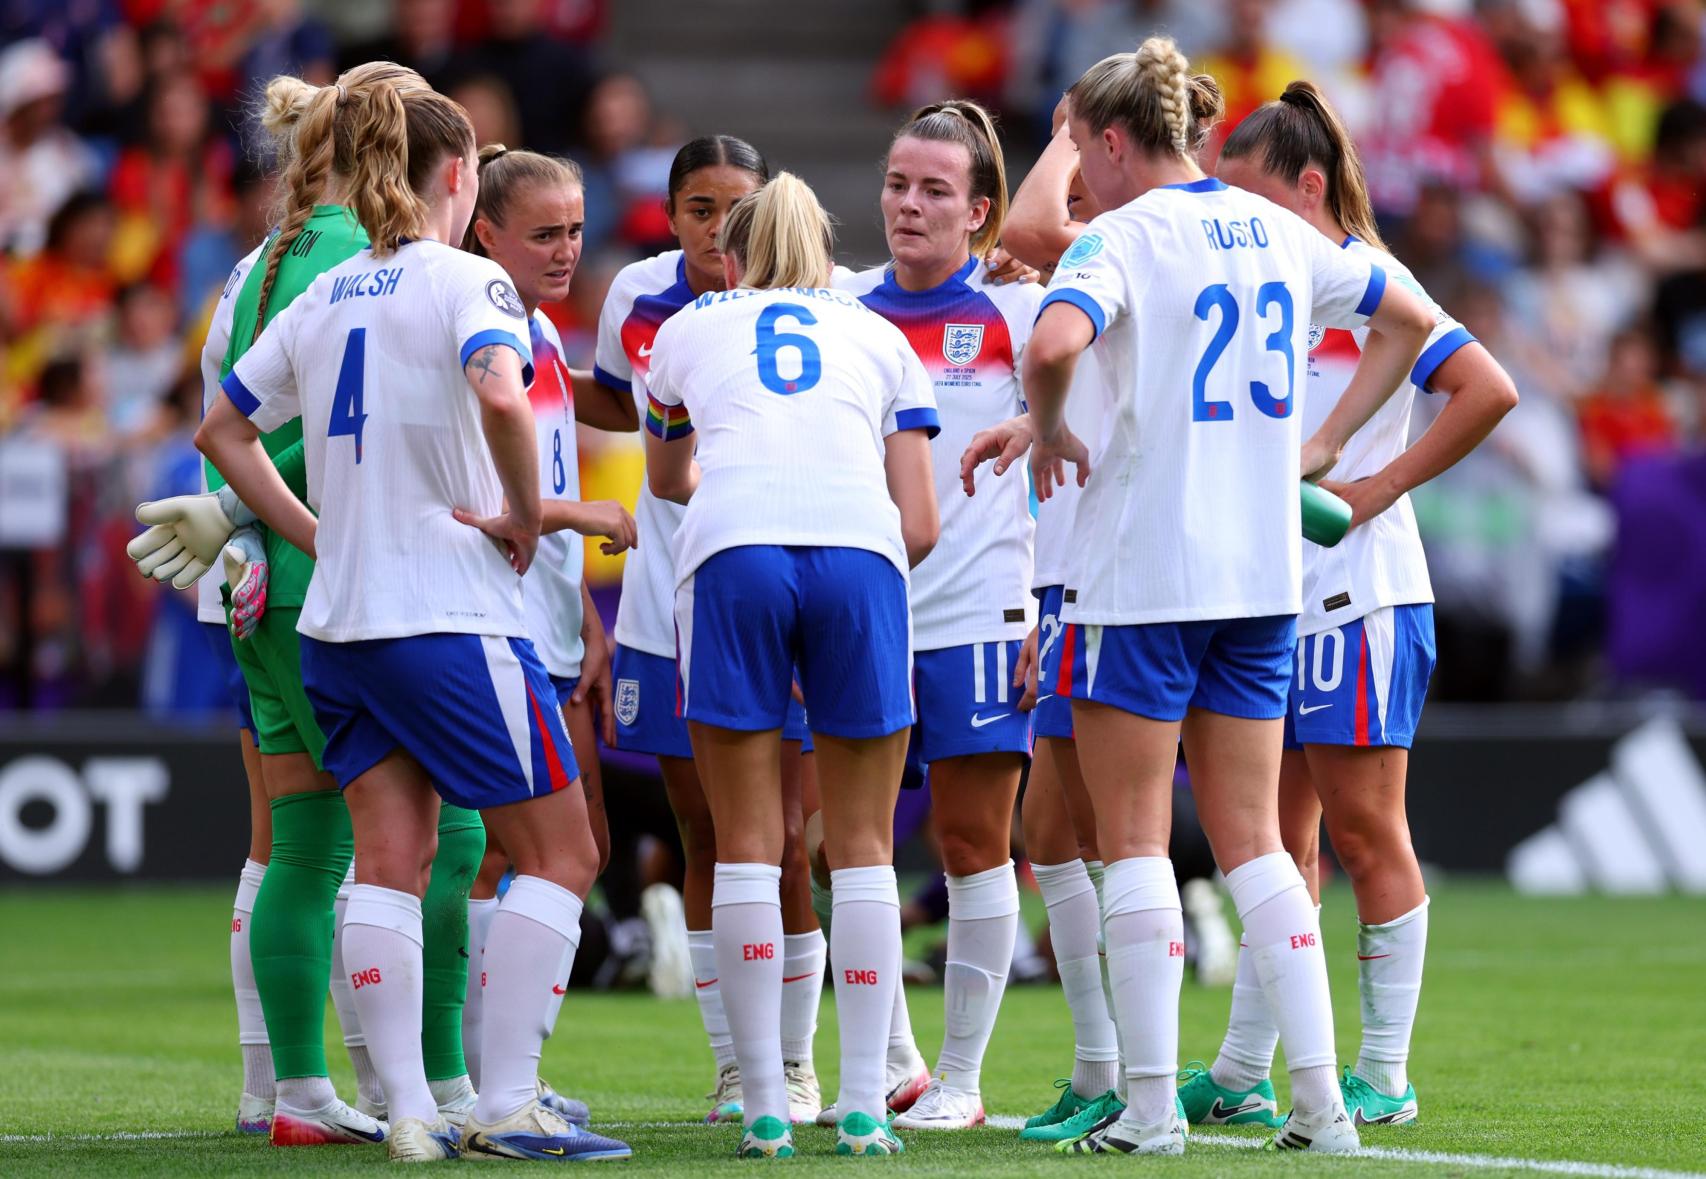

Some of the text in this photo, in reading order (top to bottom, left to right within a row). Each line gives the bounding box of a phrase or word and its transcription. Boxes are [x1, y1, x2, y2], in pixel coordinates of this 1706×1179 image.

[329, 267, 403, 304] WALSH
[752, 302, 821, 395] 6
[1193, 281, 1294, 422] 23
[328, 328, 367, 464] 4
[553, 429, 566, 494] 8
[973, 641, 1008, 703] 11
[1298, 627, 1344, 692] 10
[743, 943, 774, 961] ENG
[1290, 933, 1315, 950] ENG
[351, 968, 382, 990] ENG
[845, 969, 877, 985] ENG
